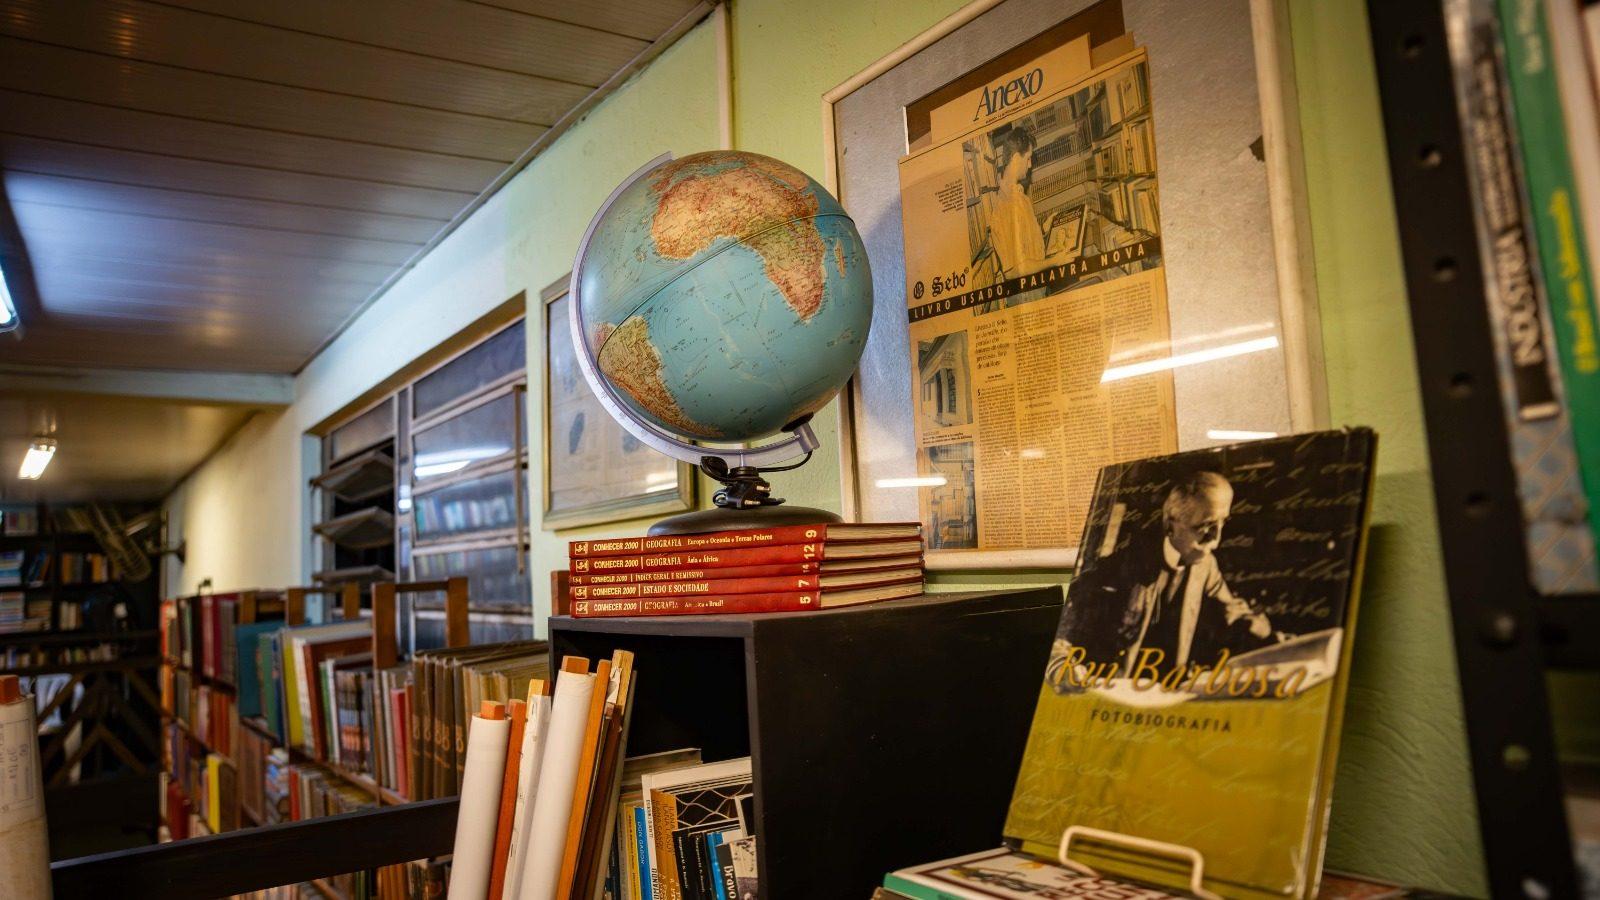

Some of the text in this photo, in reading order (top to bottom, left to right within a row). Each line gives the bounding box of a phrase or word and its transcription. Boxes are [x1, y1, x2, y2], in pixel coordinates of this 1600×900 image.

[973, 68, 1043, 121] Anexo
[914, 243, 1145, 319] LIVRO USADO, PALAVRA NOVA
[913, 281, 925, 300] O
[806, 529, 817, 538] 9
[593, 542, 623, 551] CONHECER
[646, 539, 682, 548] GEOGRAFIA
[804, 544, 815, 559] 12
[594, 560, 624, 569] CONHECER
[624, 559, 638, 568] 2000
[646, 557, 682, 567] GEOGRAFIA
[702, 555, 719, 563] África
[803, 564, 809, 573] 14
[676, 571, 703, 579] REMISSIVO
[593, 587, 622, 596] CONHECER
[644, 584, 666, 594] ESTADO
[674, 582, 708, 592] SOCIEDADE
[798, 579, 809, 588] 7
[800, 596, 811, 604] 5
[594, 603, 622, 612] CONHECER
[623, 603, 637, 611] 2000
[1054, 646, 1308, 699] Rui Barbosa
[1090, 709, 1232, 733] FOTOBIOGRAFIA
[724, 865, 736, 899] Bravo
